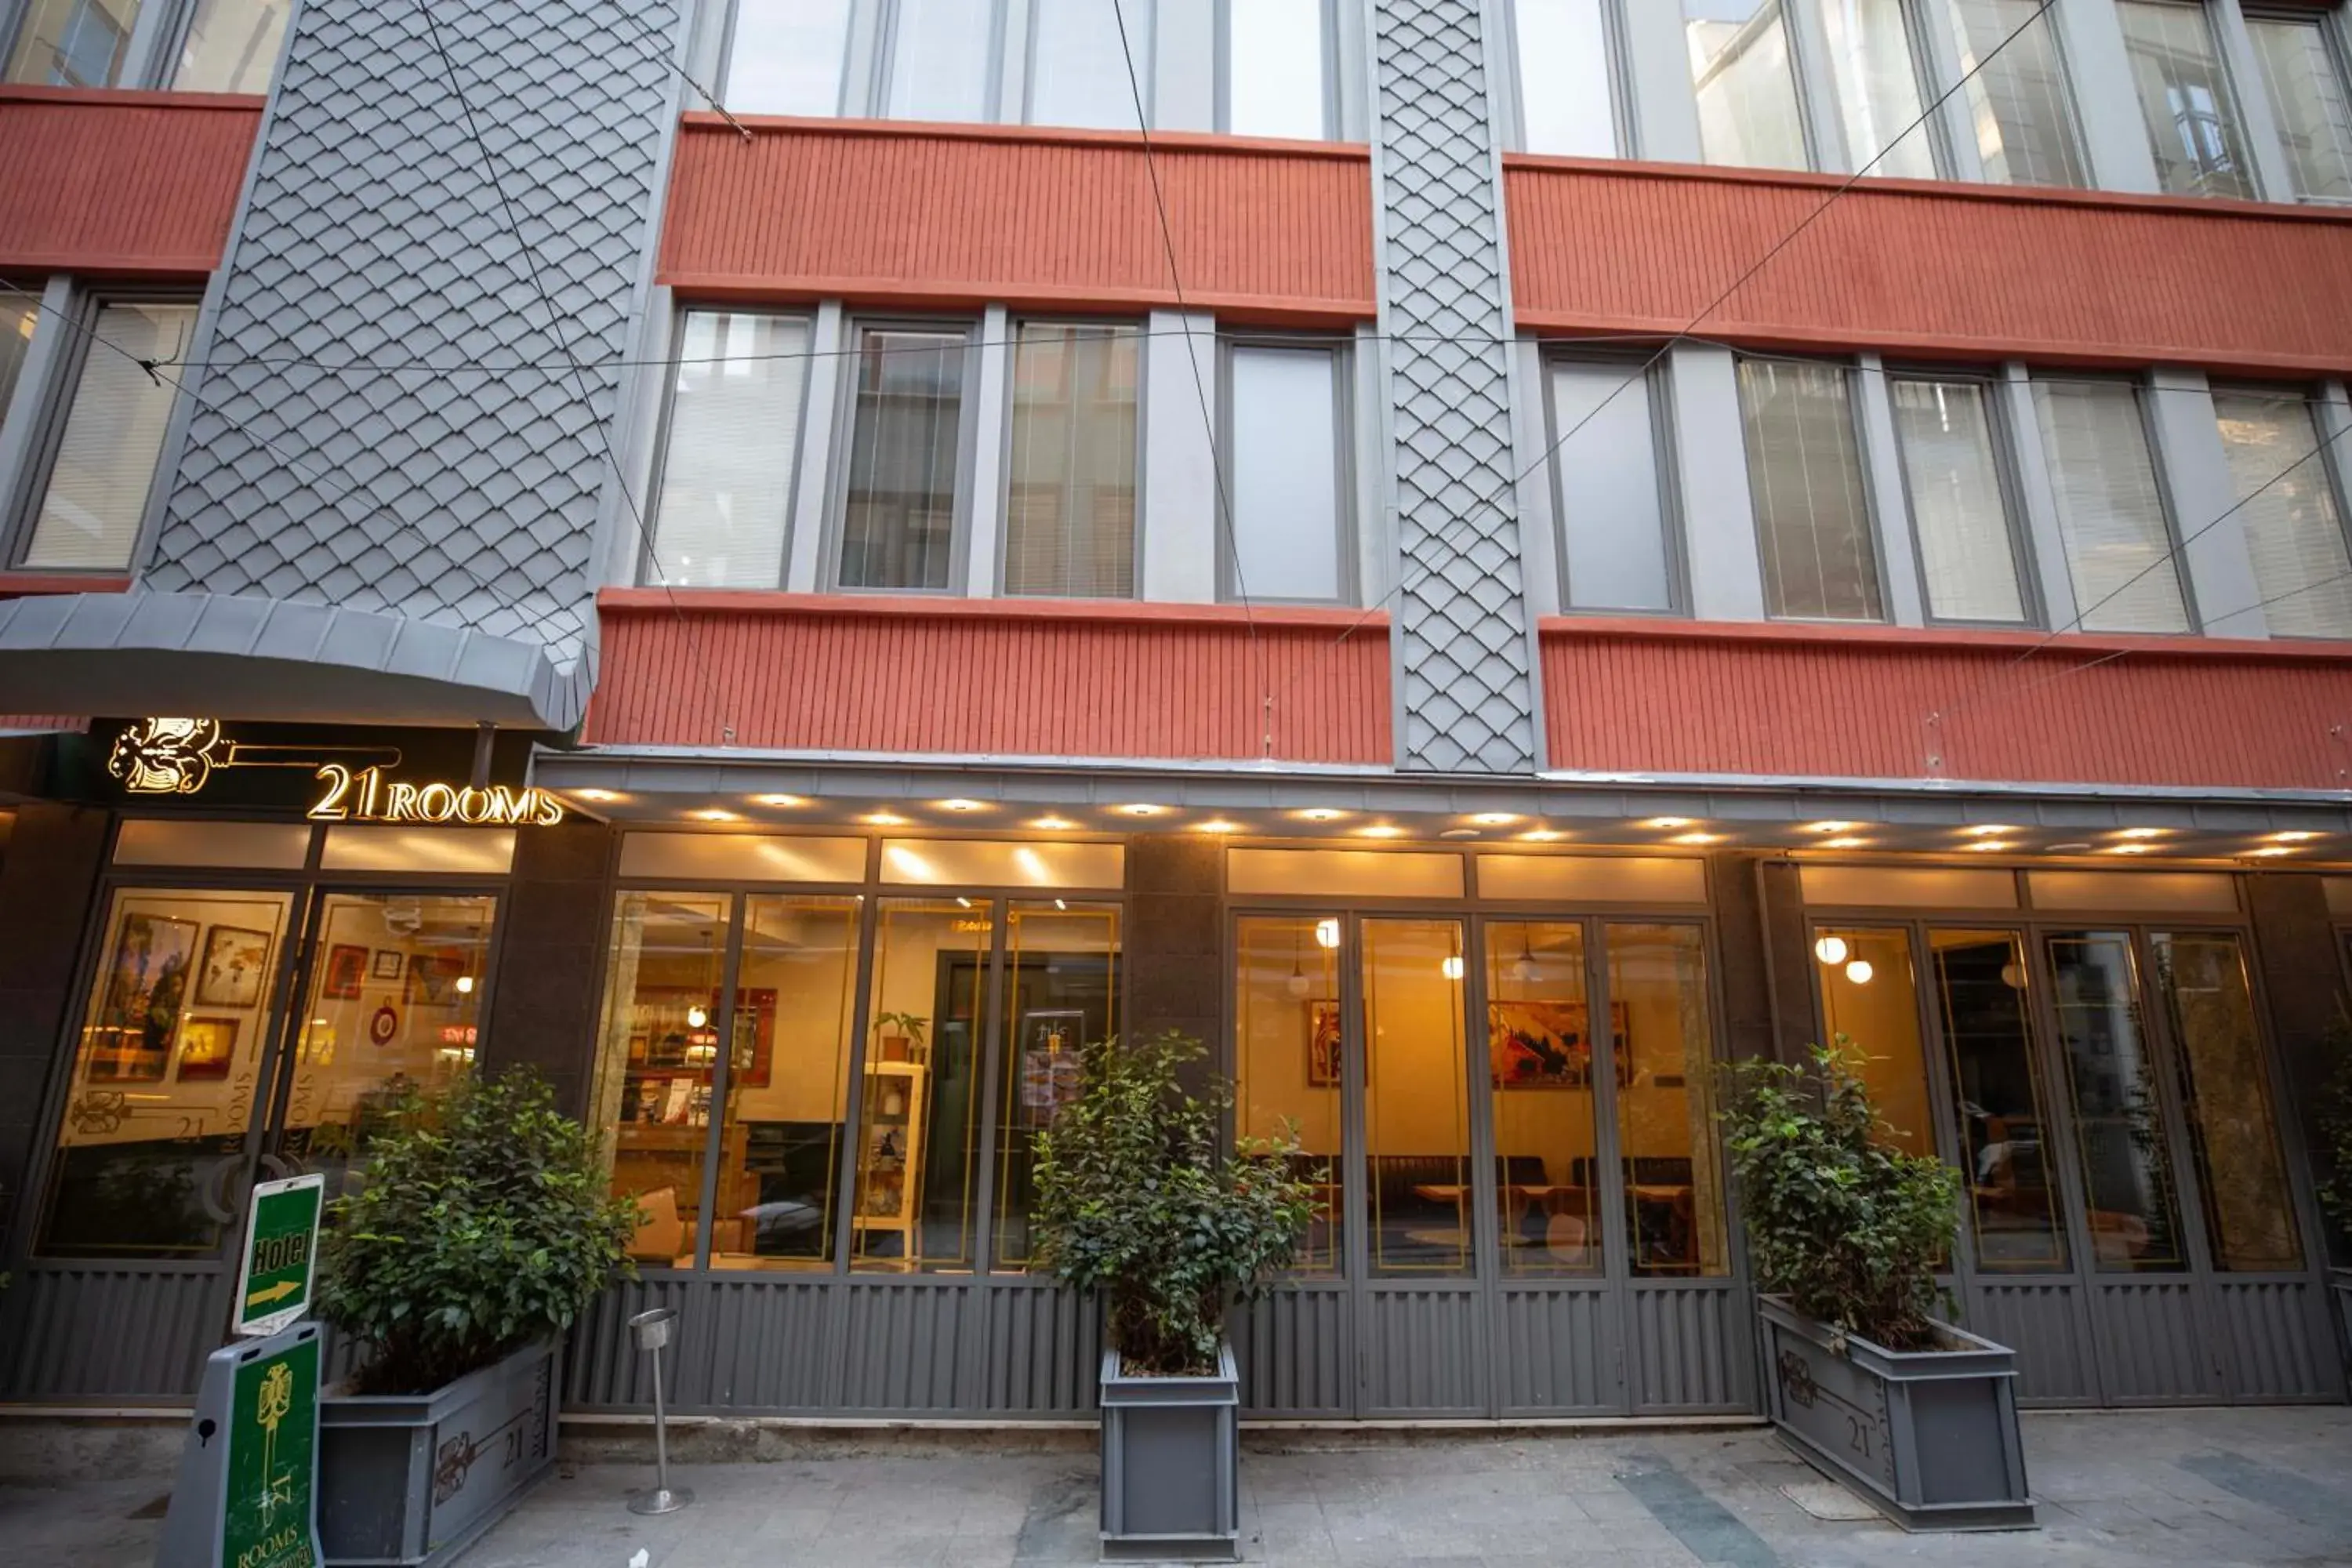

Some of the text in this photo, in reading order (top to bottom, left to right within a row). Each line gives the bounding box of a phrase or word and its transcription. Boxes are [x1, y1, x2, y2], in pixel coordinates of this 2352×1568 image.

[307, 764, 563, 826] 21 ROOMS
[172, 1116, 205, 1144] 21
[251, 1228, 311, 1276] Hotel
[503, 1424, 523, 1471] 21
[1846, 1414, 1871, 1459] 21
